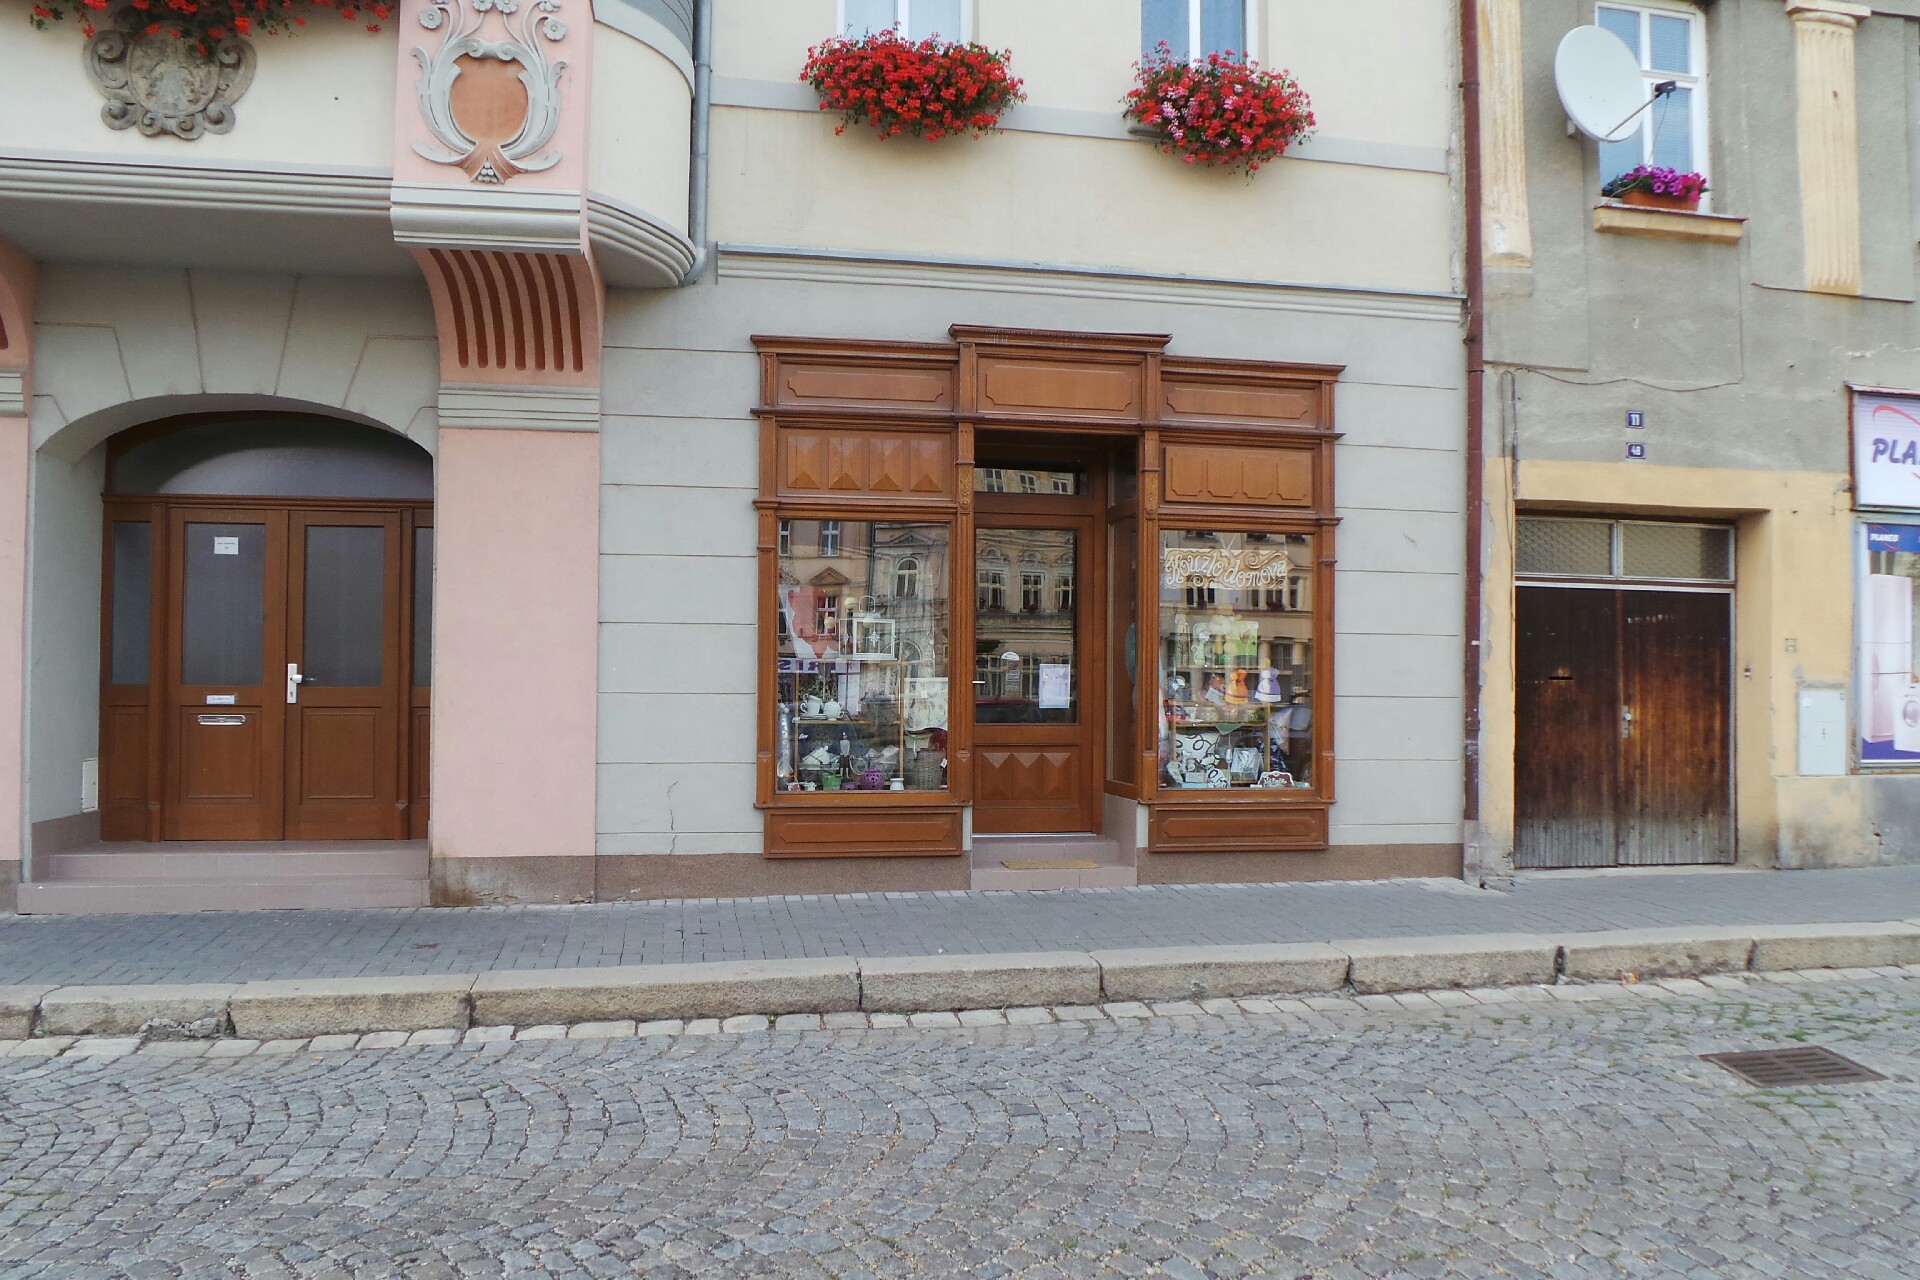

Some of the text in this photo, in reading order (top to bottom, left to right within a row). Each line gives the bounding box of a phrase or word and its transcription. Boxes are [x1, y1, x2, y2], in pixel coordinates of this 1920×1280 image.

[1630, 413, 1640, 426] 11
[1872, 437, 1920, 465] PLA
[1164, 552, 1288, 588] Kouzlo domova
